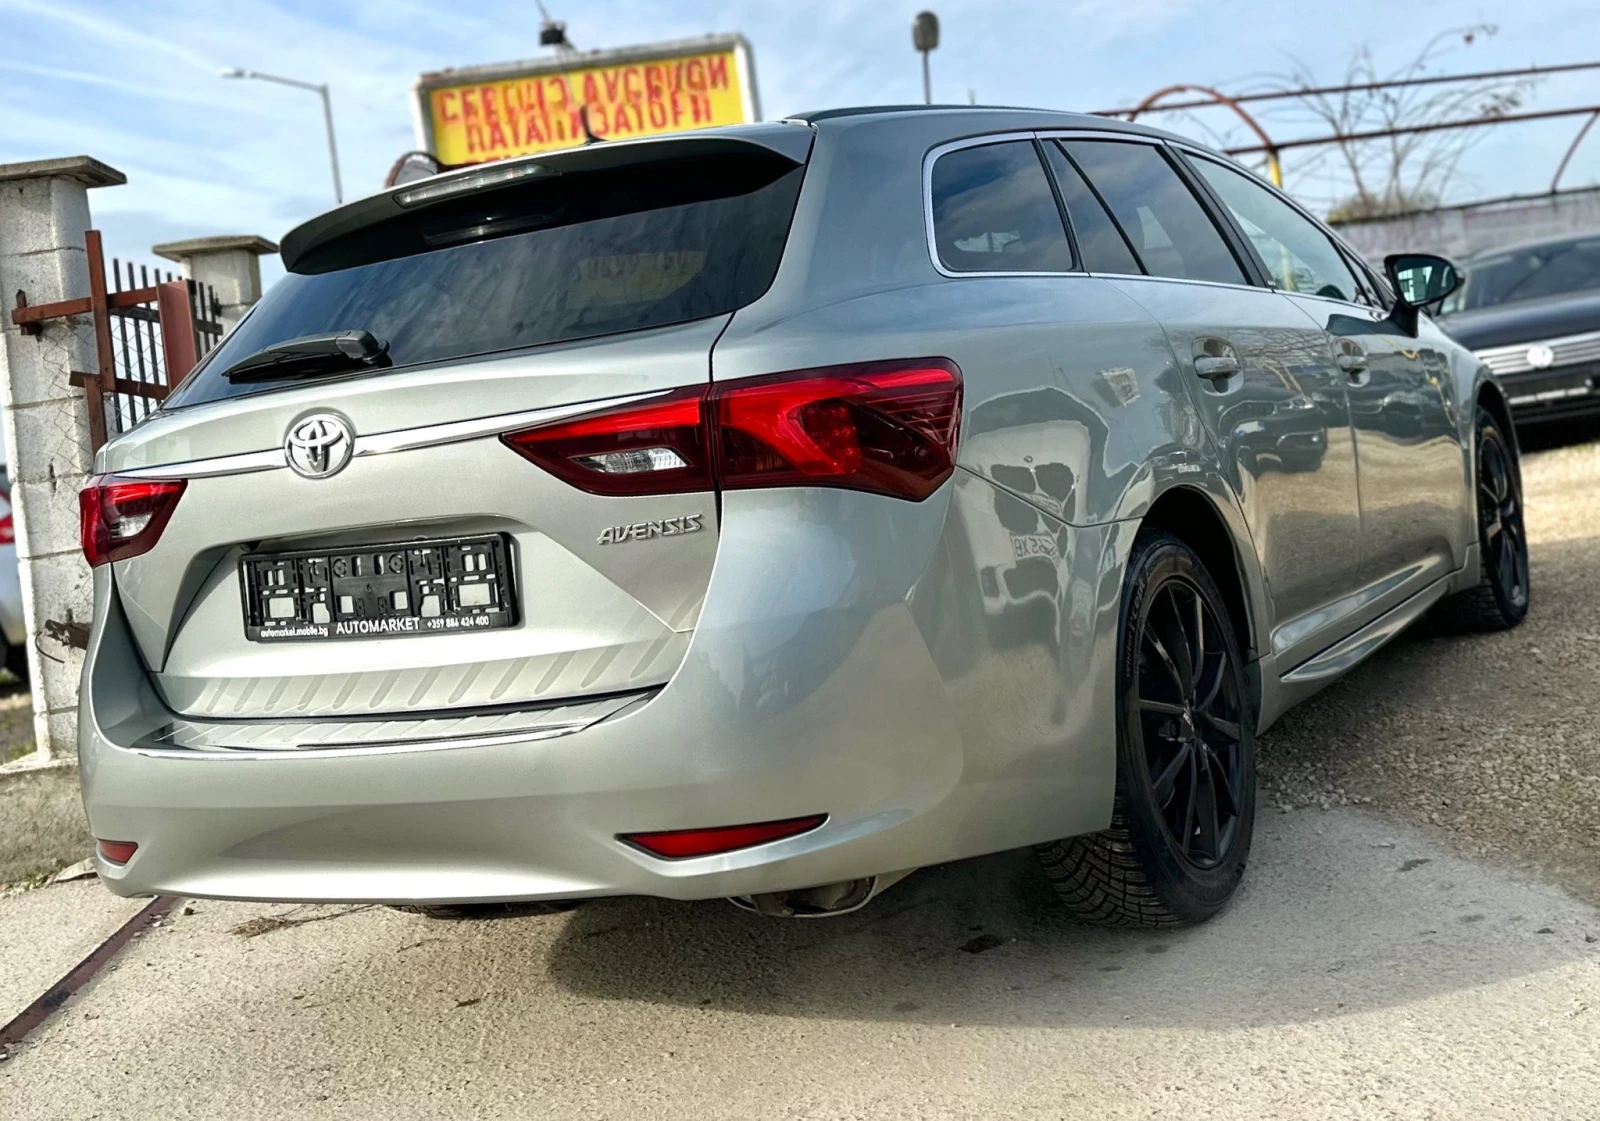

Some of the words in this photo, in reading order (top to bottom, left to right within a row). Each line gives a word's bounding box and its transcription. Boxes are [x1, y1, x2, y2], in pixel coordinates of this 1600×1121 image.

[596, 514, 702, 545] AVENSIS
[336, 617, 420, 635] AUTOMARKET
[426, 618, 445, 629] +359
[460, 616, 475, 627] 424
[475, 615, 490, 626] 400
